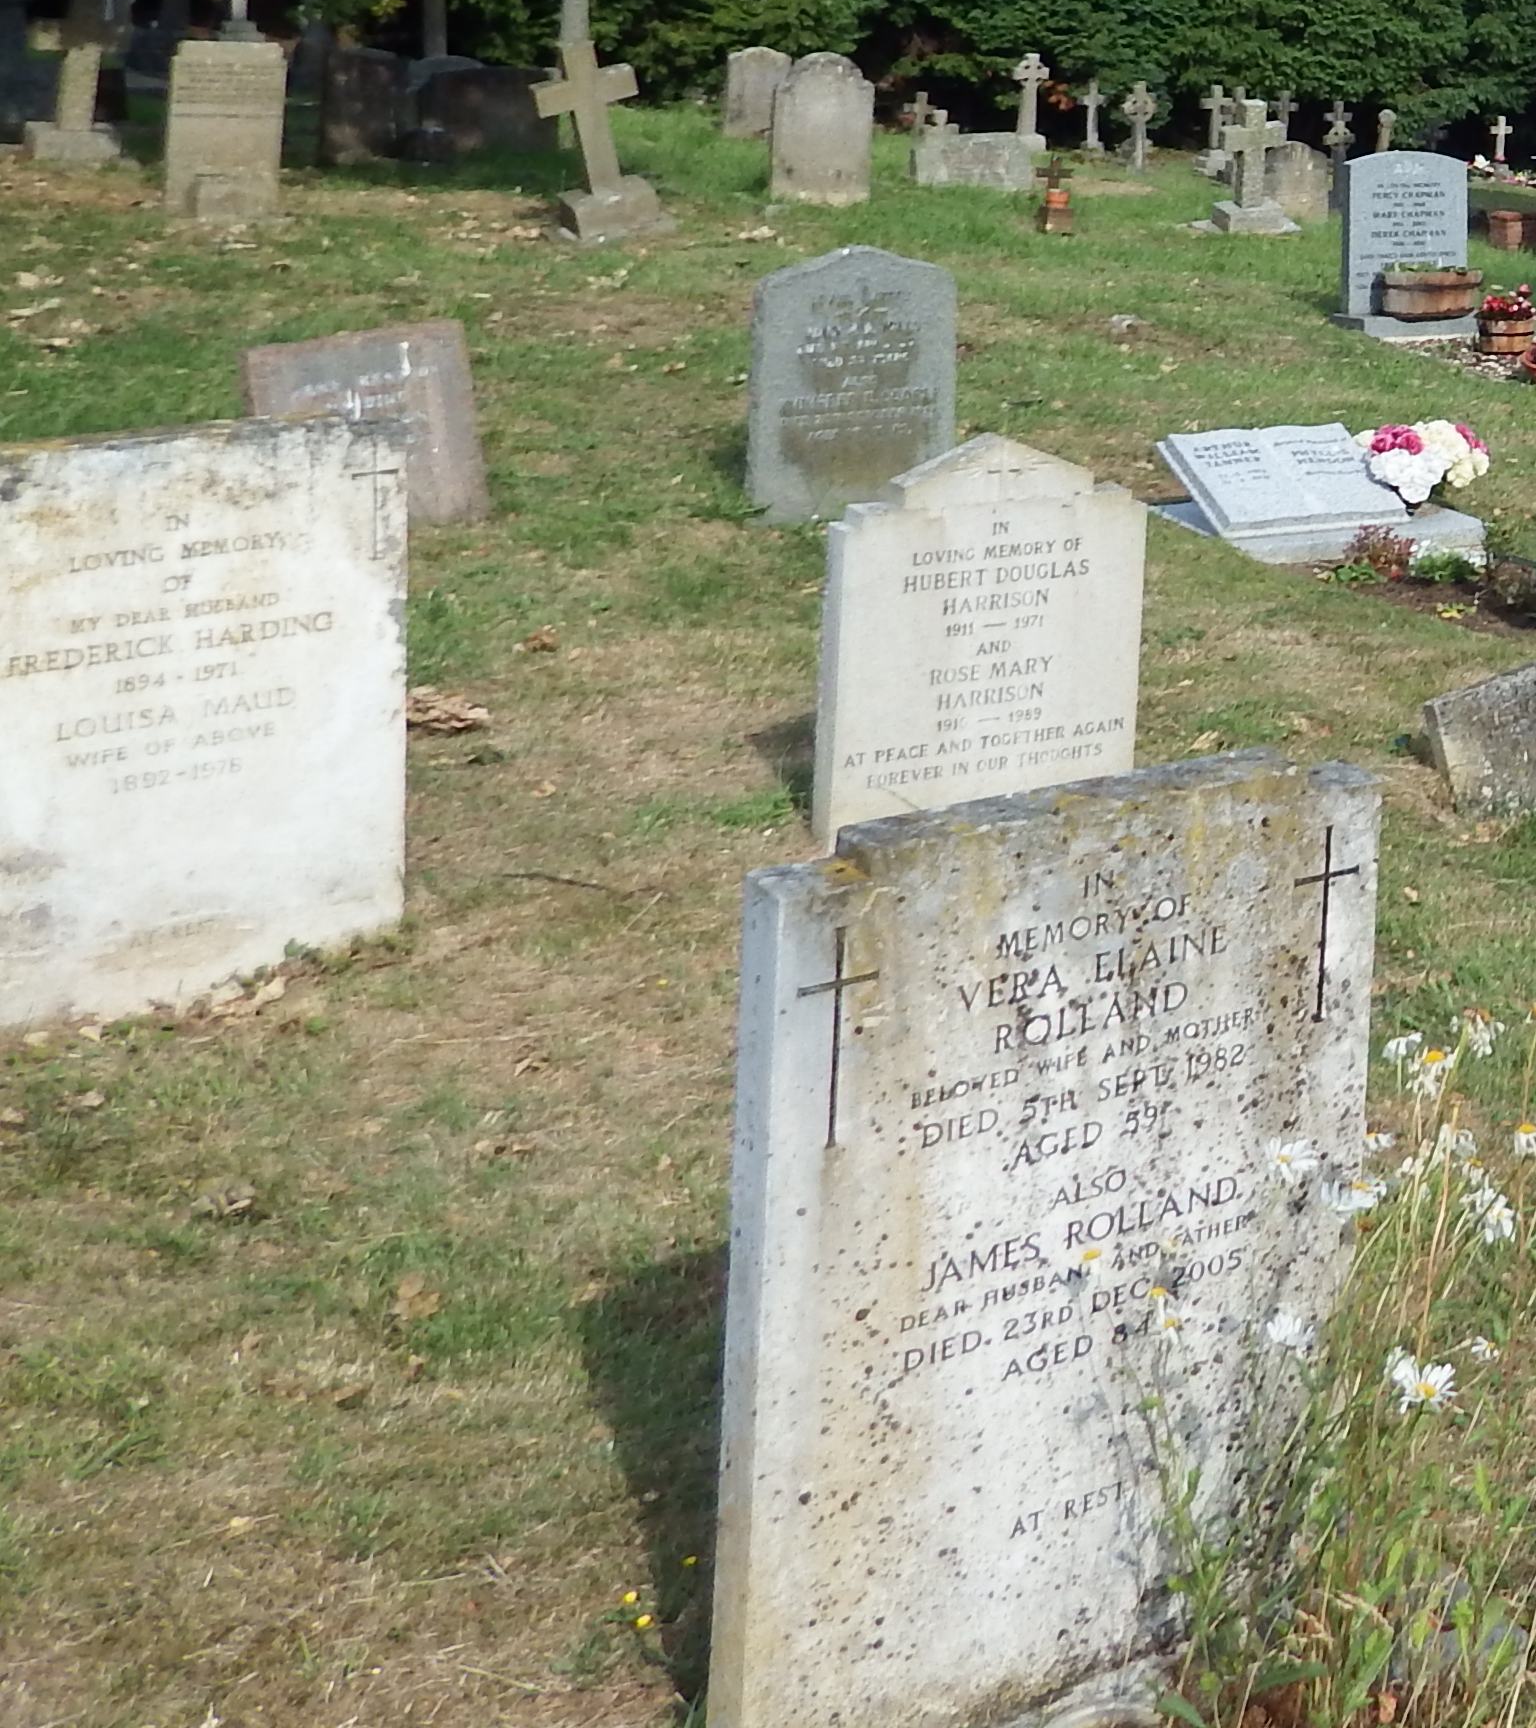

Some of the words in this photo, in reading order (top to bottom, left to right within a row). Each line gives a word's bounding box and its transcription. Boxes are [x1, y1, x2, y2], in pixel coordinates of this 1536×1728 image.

[164, 513, 190, 532] IN
[991, 520, 1010, 537] IN
[69, 546, 165, 574] LOVING
[912, 546, 976, 567] LOVING
[983, 538, 1057, 561] MEMORY
[1063, 536, 1083, 552] OF
[163, 573, 194, 594] OF
[902, 567, 988, 594] HUBERT
[995, 558, 1091, 585] DOUGLAS
[115, 607, 170, 629] DEAR
[184, 592, 280, 620] HUSBAND
[942, 587, 1050, 616] HARRISON
[946, 621, 975, 637] 1911
[1014, 614, 1044, 630] 1971
[5, 632, 175, 678] FREDERICK
[195, 610, 333, 651] HARDING
[975, 638, 1012, 657] AND
[115, 672, 166, 695] 1894
[929, 663, 982, 687] ROSE
[988, 654, 1055, 681] MARY
[56, 704, 176, 743] LOUISA
[203, 685, 297, 719] MAUD
[936, 681, 1045, 712] HARRISON
[66, 745, 128, 768] WIFE
[145, 738, 176, 757] OF
[192, 720, 276, 750] ABOVE
[843, 750, 867, 769] AT
[874, 743, 929, 765] PEACE
[934, 737, 973, 757] AND
[979, 724, 1066, 750] TOGETHER
[1072, 716, 1126, 738] AGAIN
[865, 764, 945, 790] FOREVER
[951, 760, 970, 776] IN
[975, 755, 1010, 772] OUR
[1017, 742, 1104, 769] THOUGHTS
[1082, 871, 1115, 899] IN
[997, 906, 1133, 960] MEMORY
[1153, 893, 1193, 922] OF
[959, 962, 1069, 1013] VERA
[1093, 924, 1229, 984] ELAINE
[994, 980, 1189, 1055] ROLLAND
[911, 1068, 1020, 1111] BELOVED
[1036, 1045, 1089, 1076] WIFE
[1101, 1034, 1151, 1064] AND
[1164, 1007, 1256, 1044] MOTHER
[920, 1108, 999, 1150] DIED
[1018, 1089, 1080, 1124] 5TH
[1097, 1062, 1172, 1103] SEPT
[1186, 1043, 1247, 1082] 1982
[1009, 1120, 1104, 1172] AGED
[1122, 1104, 1160, 1139] 59
[1050, 1168, 1129, 1210] ALSO
[920, 1232, 1042, 1293] JAMES
[1064, 1175, 1239, 1251] ROLLAND
[899, 1299, 970, 1334] DEAR
[1111, 1239, 1161, 1272] AND
[902, 1329, 982, 1374] DIED
[1003, 1304, 1074, 1342] 23RD
[1170, 1246, 1243, 1290] 2005
[1001, 1333, 1094, 1382] AGED
[1111, 1312, 1151, 1346] 84
[1009, 1508, 1045, 1540] AT
[1063, 1480, 1122, 1521] REST
